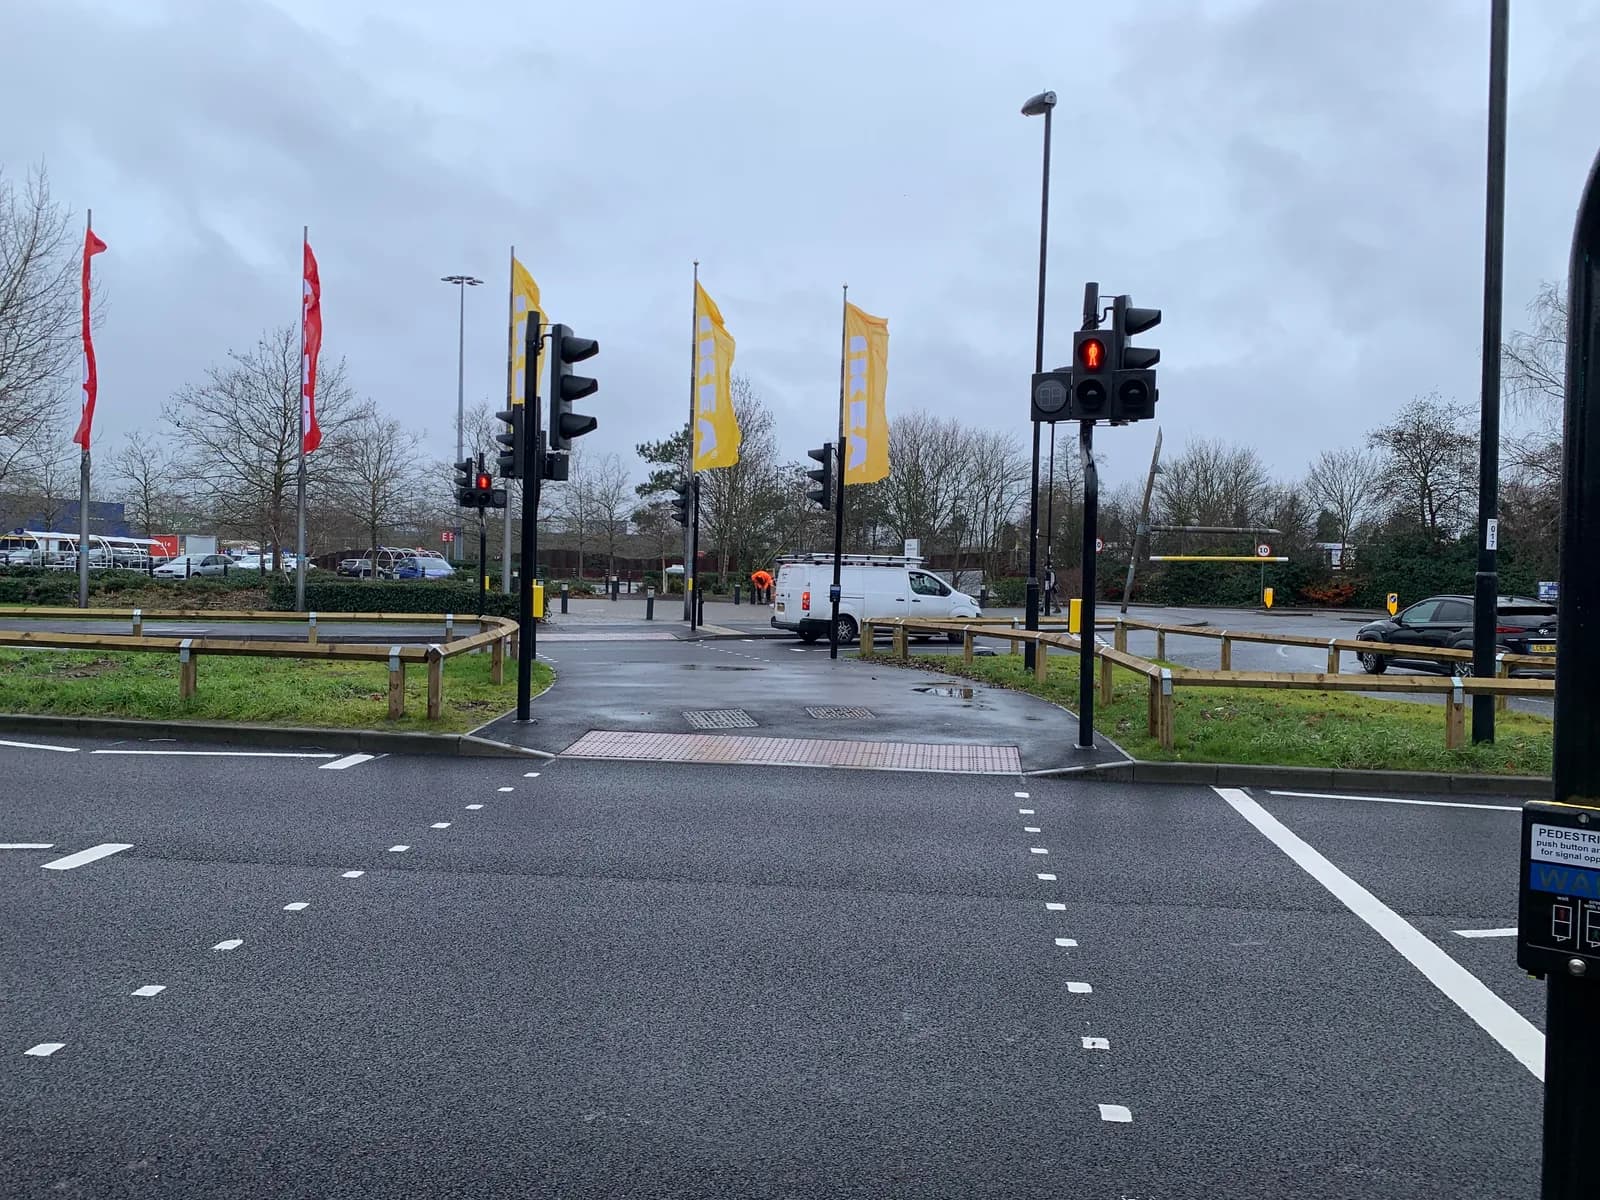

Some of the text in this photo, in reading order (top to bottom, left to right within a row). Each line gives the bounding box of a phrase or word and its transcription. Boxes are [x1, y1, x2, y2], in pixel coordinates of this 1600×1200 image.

[698, 315, 717, 458] IKEA
[848, 335, 867, 471] IKEA
[1259, 546, 1269, 554] 10
[1539, 828, 1600, 844] PEDESTRI
[1536, 840, 1558, 848] push
[1560, 842, 1589, 852] button
[1541, 848, 1553, 856] for
[1555, 850, 1582, 860] signal
